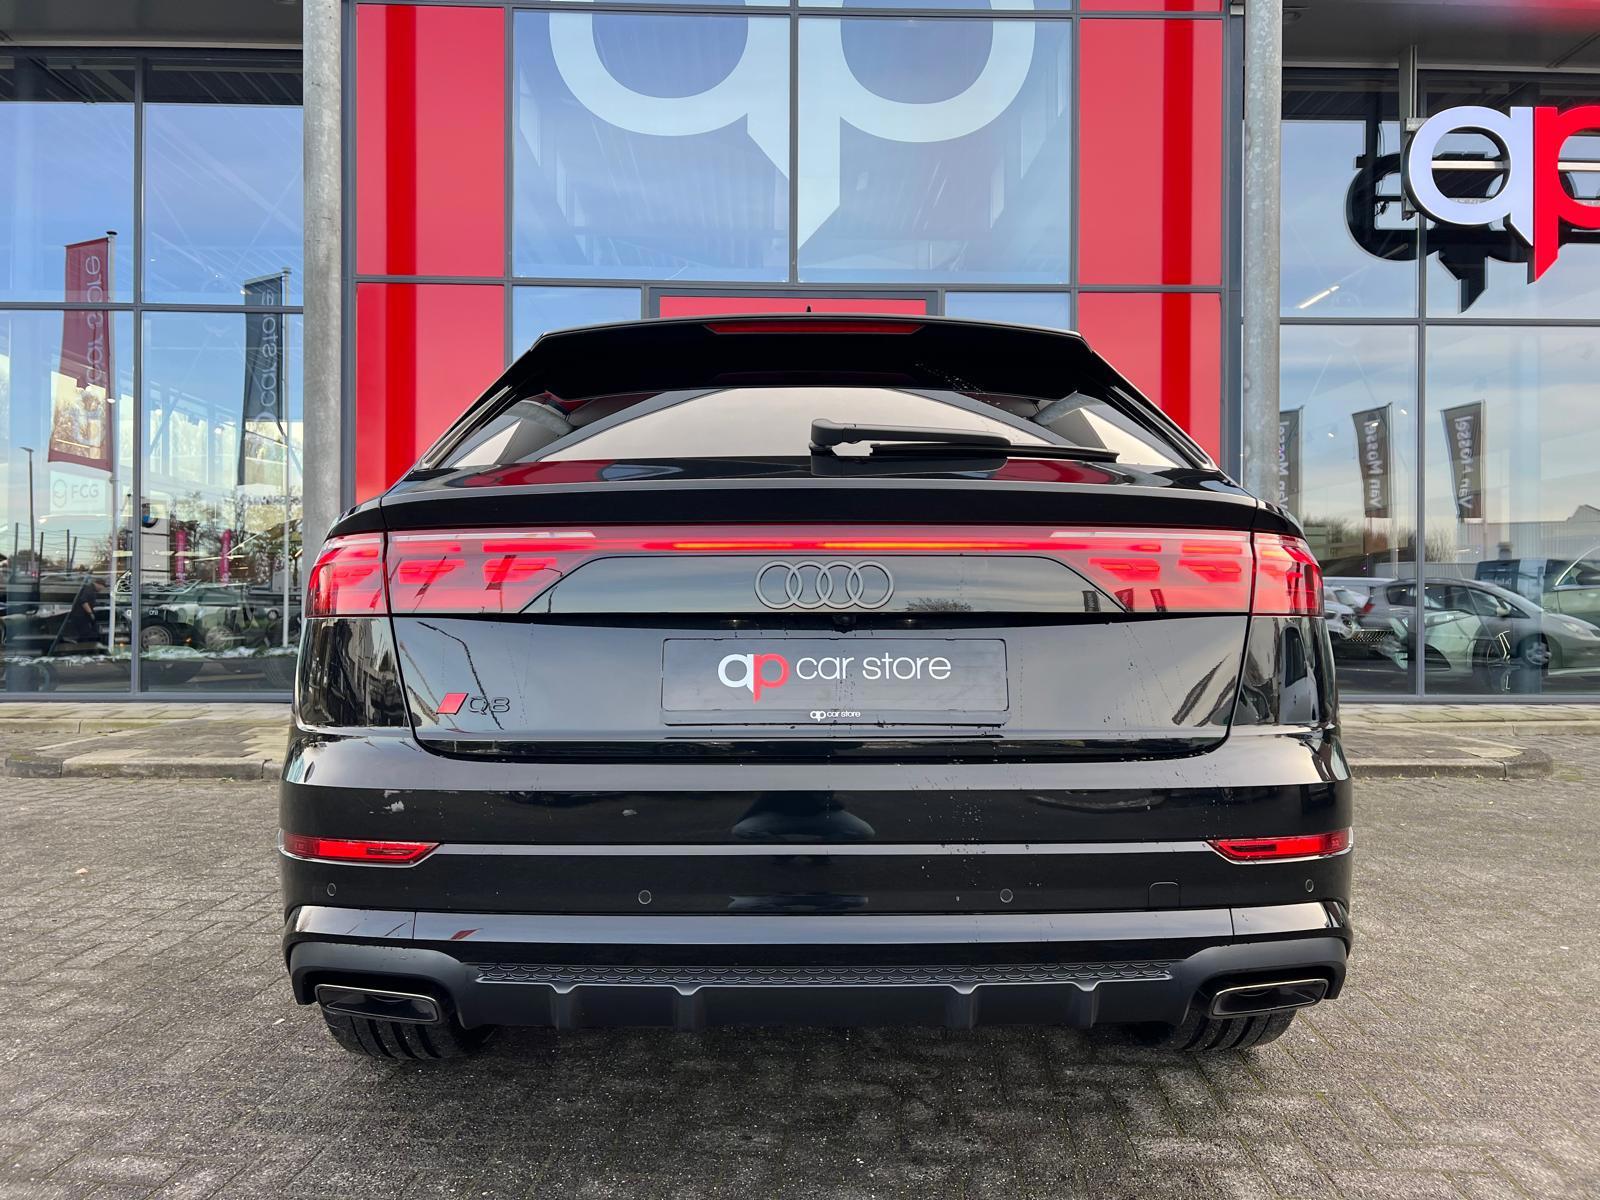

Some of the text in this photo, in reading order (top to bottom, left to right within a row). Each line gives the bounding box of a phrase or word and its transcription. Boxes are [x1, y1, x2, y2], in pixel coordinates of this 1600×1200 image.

[71, 484, 99, 499] FCG
[796, 656, 854, 680] car
[862, 652, 952, 680] store
[469, 697, 511, 715] Q8
